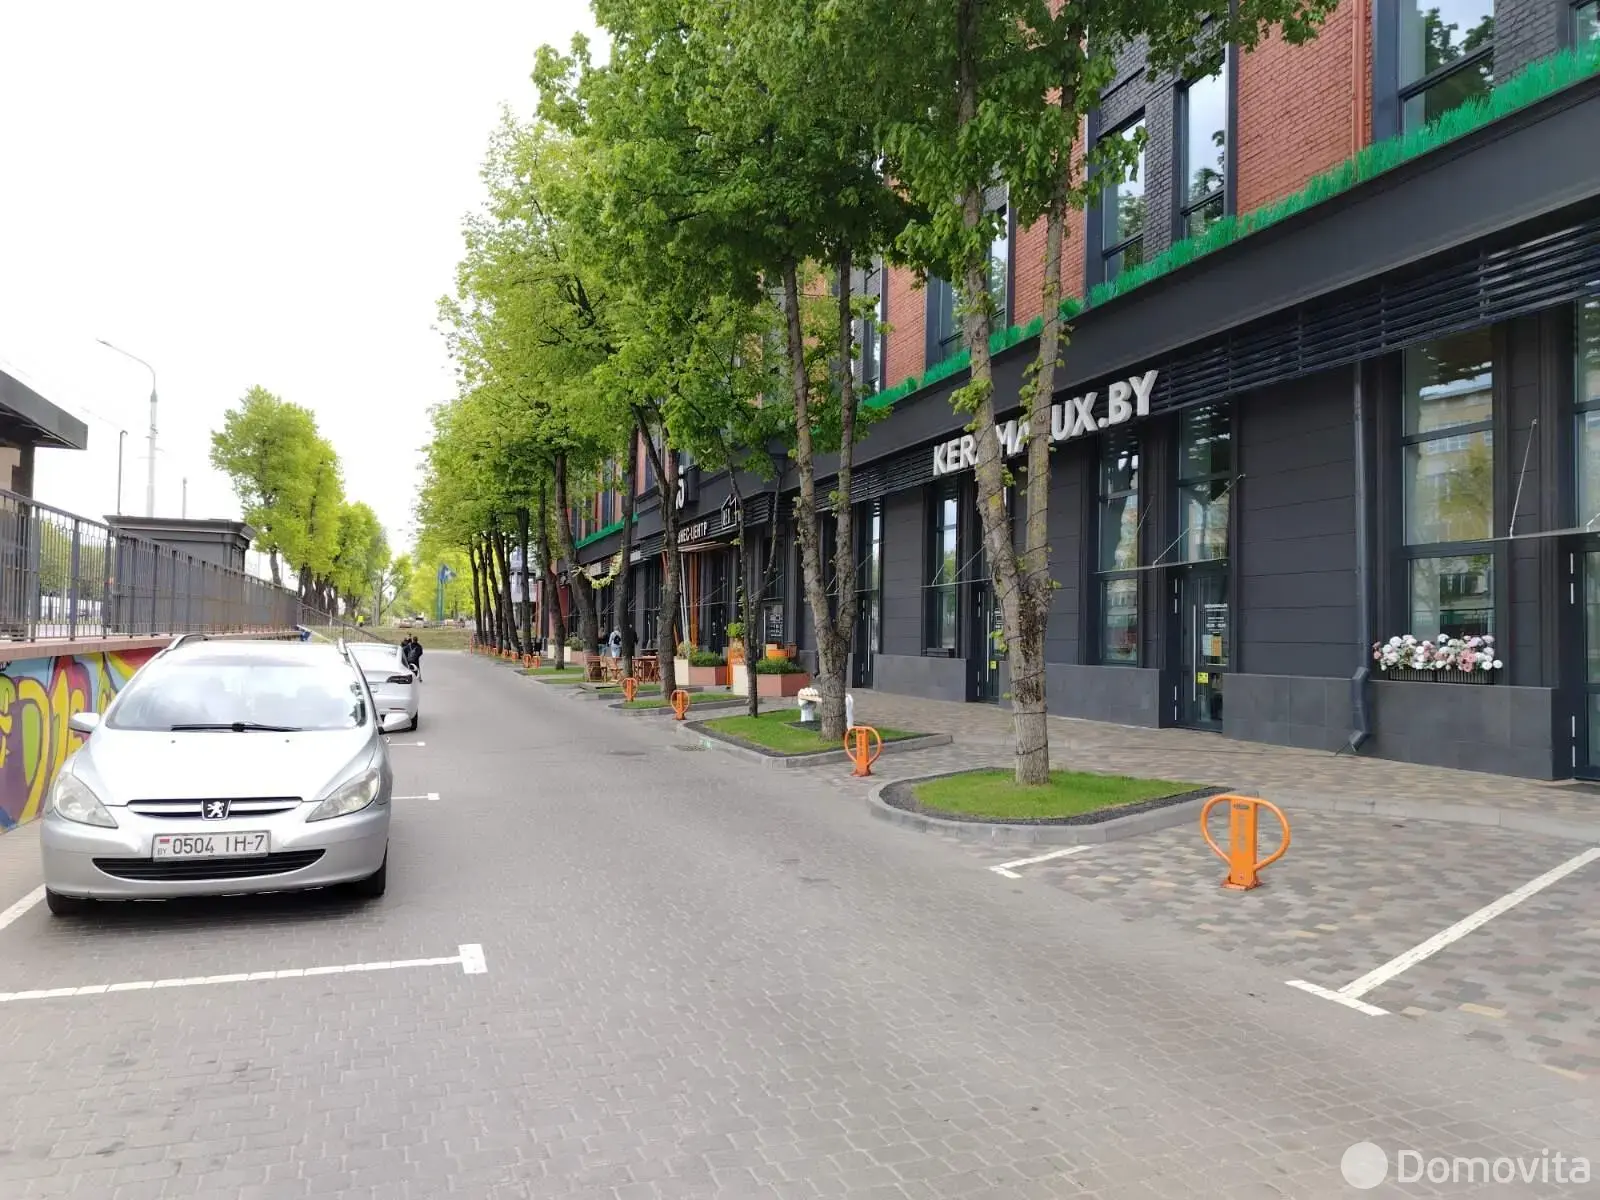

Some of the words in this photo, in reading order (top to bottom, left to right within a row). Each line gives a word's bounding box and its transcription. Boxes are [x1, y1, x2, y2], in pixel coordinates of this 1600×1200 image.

[932, 369, 1159, 476] KERMAUX.BY
[172, 836, 214, 855] 0504
[225, 834, 265, 853] IH-7
